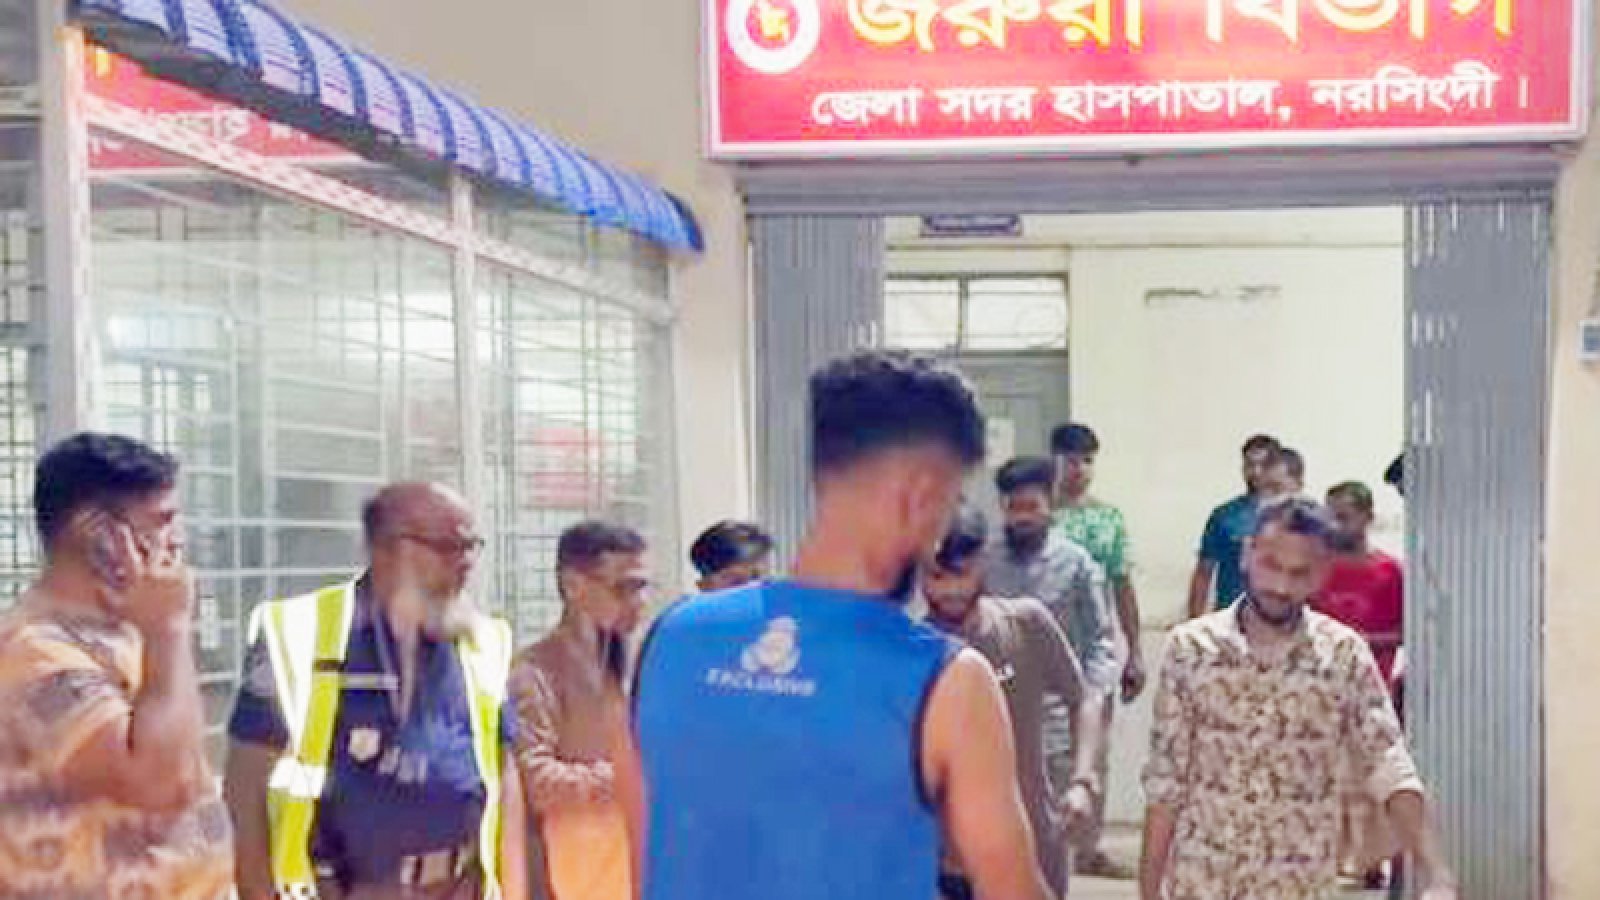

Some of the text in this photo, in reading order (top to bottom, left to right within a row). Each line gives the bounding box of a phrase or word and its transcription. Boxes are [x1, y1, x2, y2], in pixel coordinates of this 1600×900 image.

[811, 89, 921, 126] জেলা
[937, 85, 1037, 122] সদর
[1050, 80, 1293, 123] হাসপাতাল,
[1309, 60, 1500, 114] নরসিংদী
